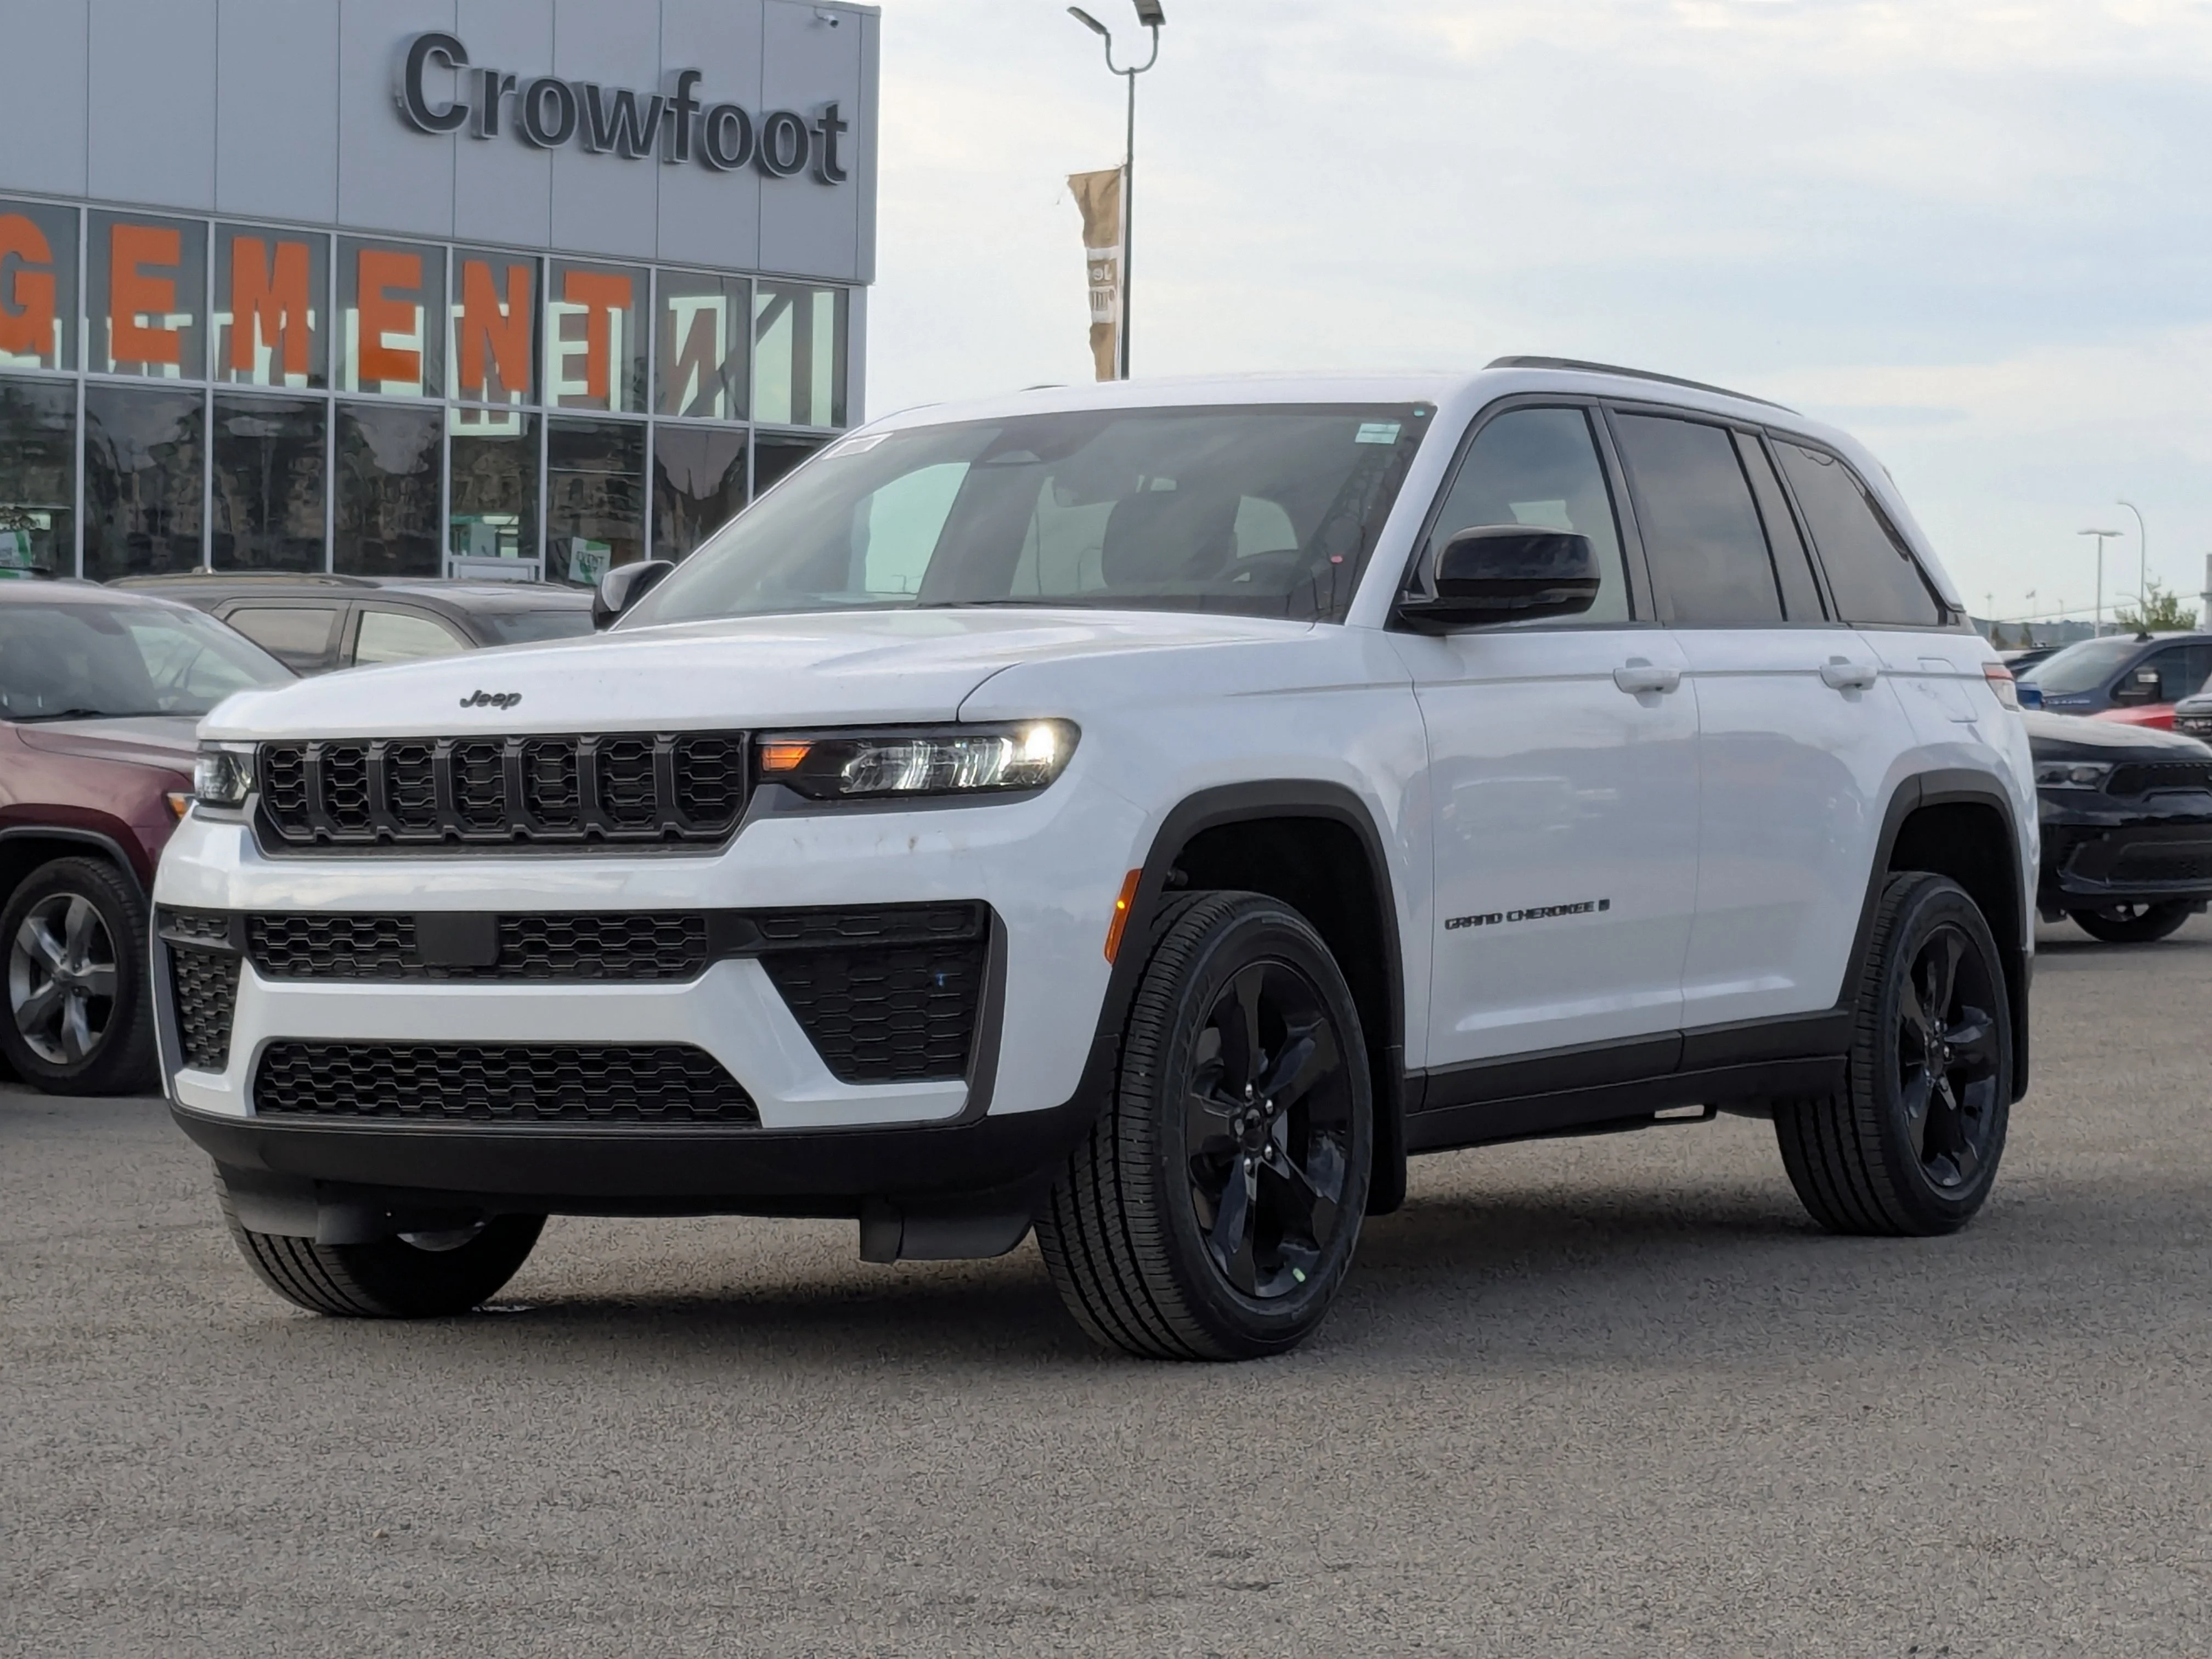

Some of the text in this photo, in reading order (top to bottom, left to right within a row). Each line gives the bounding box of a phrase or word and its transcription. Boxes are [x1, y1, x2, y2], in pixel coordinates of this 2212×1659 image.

[400, 31, 848, 184] Crowfoot
[460, 690, 522, 710] Jeep
[1444, 901, 1595, 930] GRAND CHEROKEE
